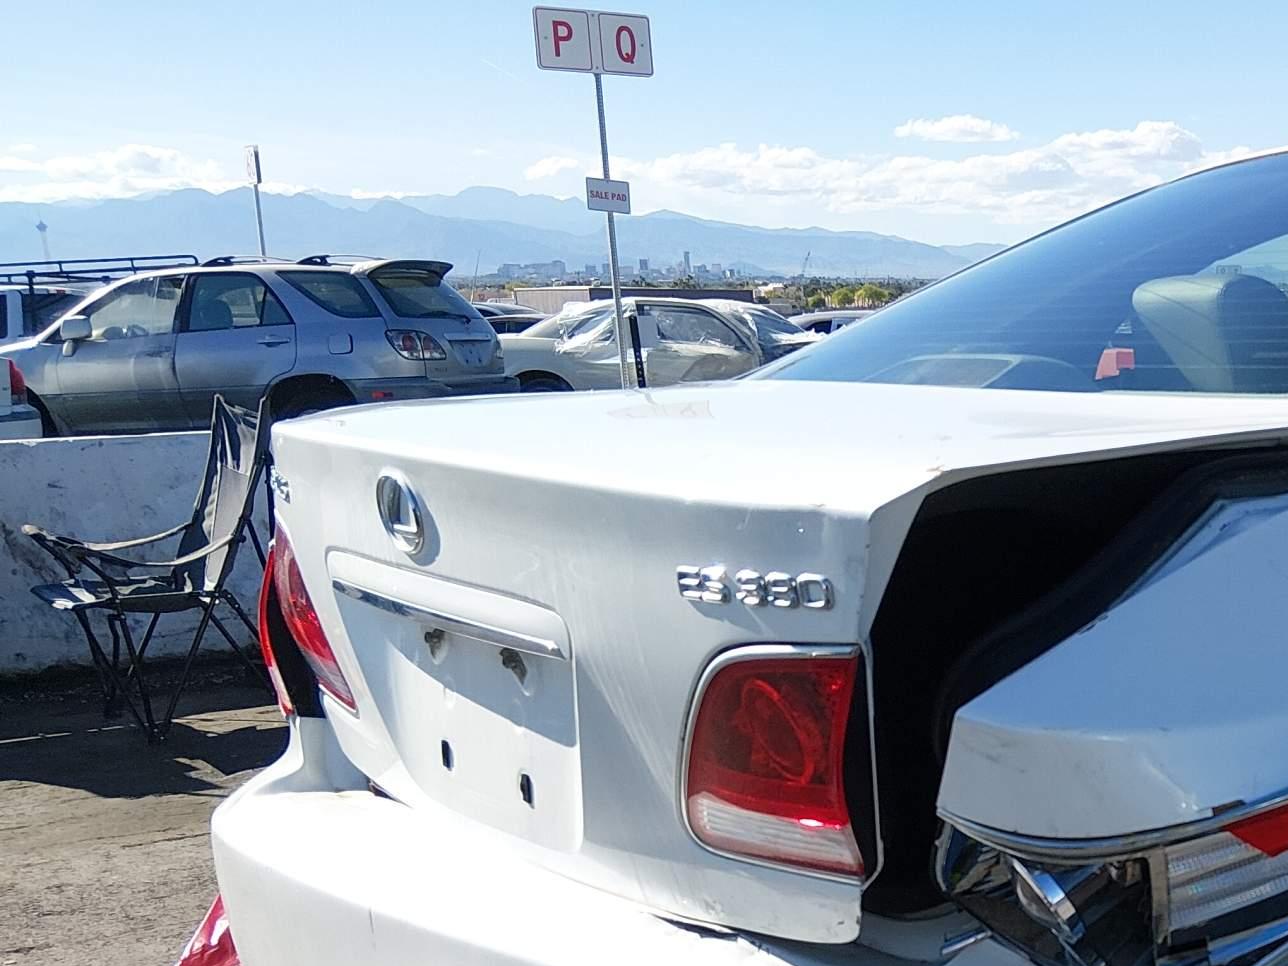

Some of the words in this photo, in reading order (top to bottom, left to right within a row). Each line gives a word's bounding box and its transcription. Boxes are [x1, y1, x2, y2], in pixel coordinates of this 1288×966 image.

[552, 20, 573, 57] P
[615, 25, 637, 64] Q
[590, 190, 609, 200] SALE
[611, 192, 627, 202] PAD
